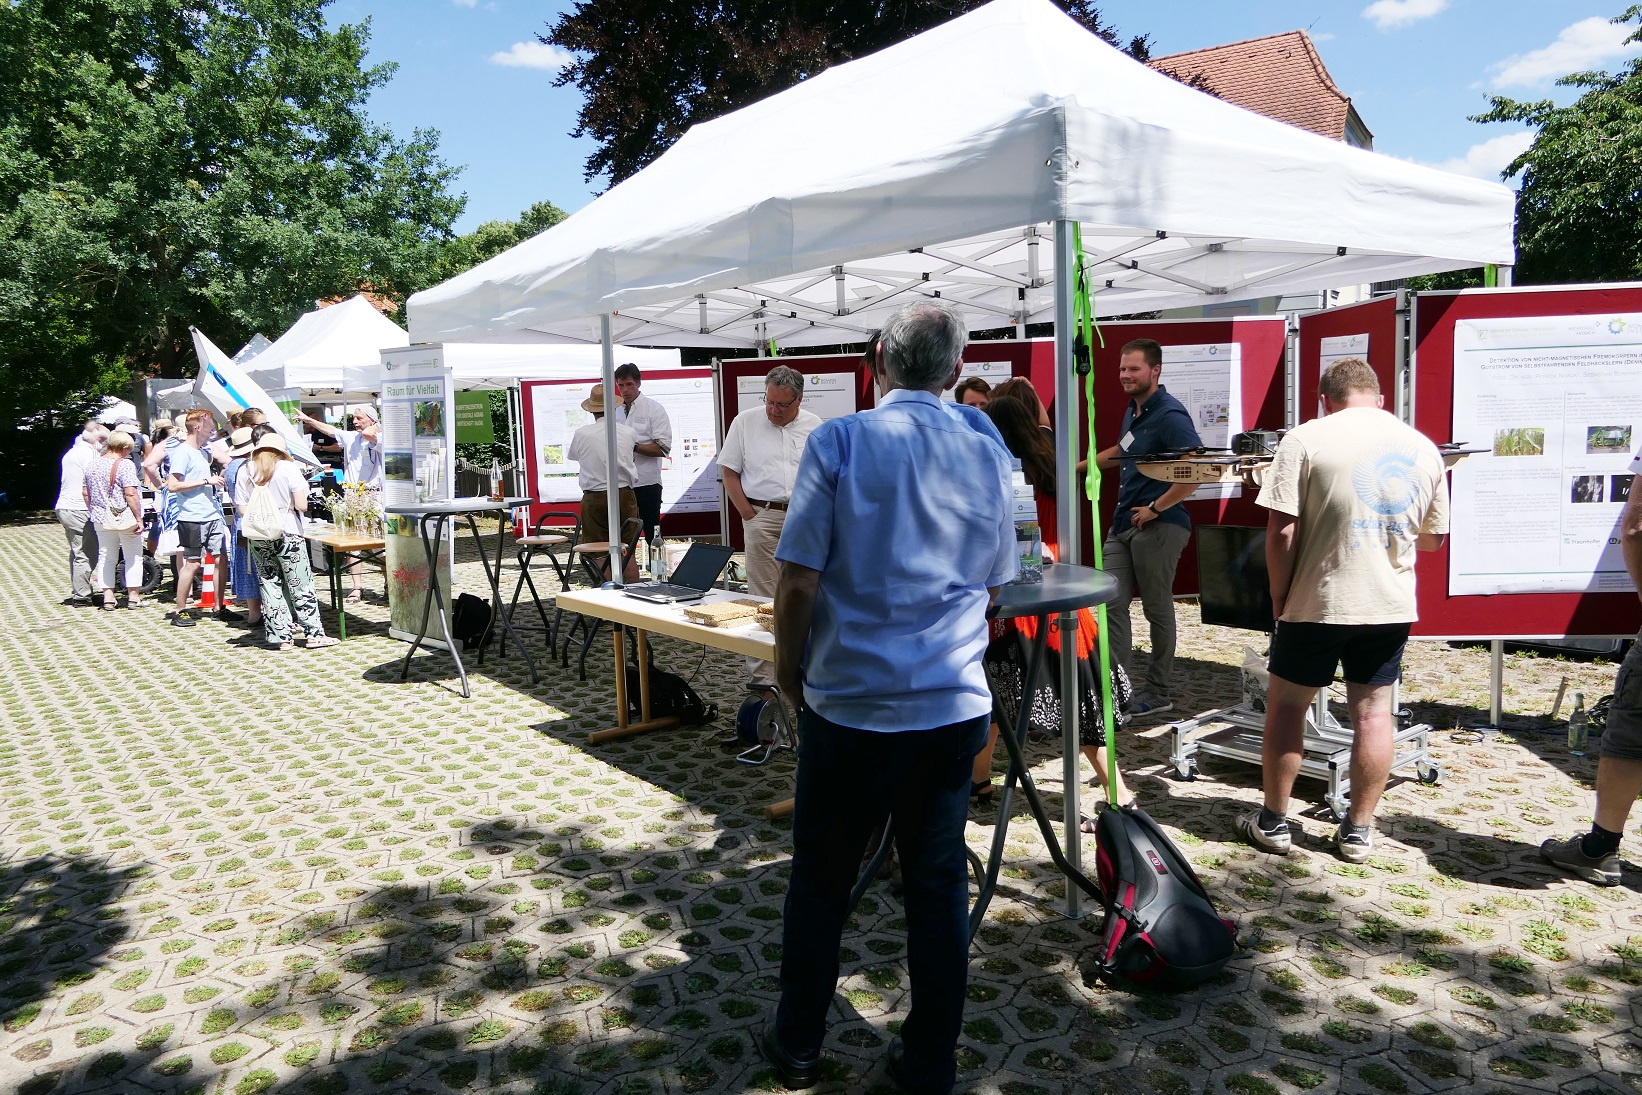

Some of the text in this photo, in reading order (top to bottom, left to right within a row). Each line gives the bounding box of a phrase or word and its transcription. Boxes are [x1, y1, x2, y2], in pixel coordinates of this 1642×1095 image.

[387, 384, 439, 396] Raum für Vielfalt
